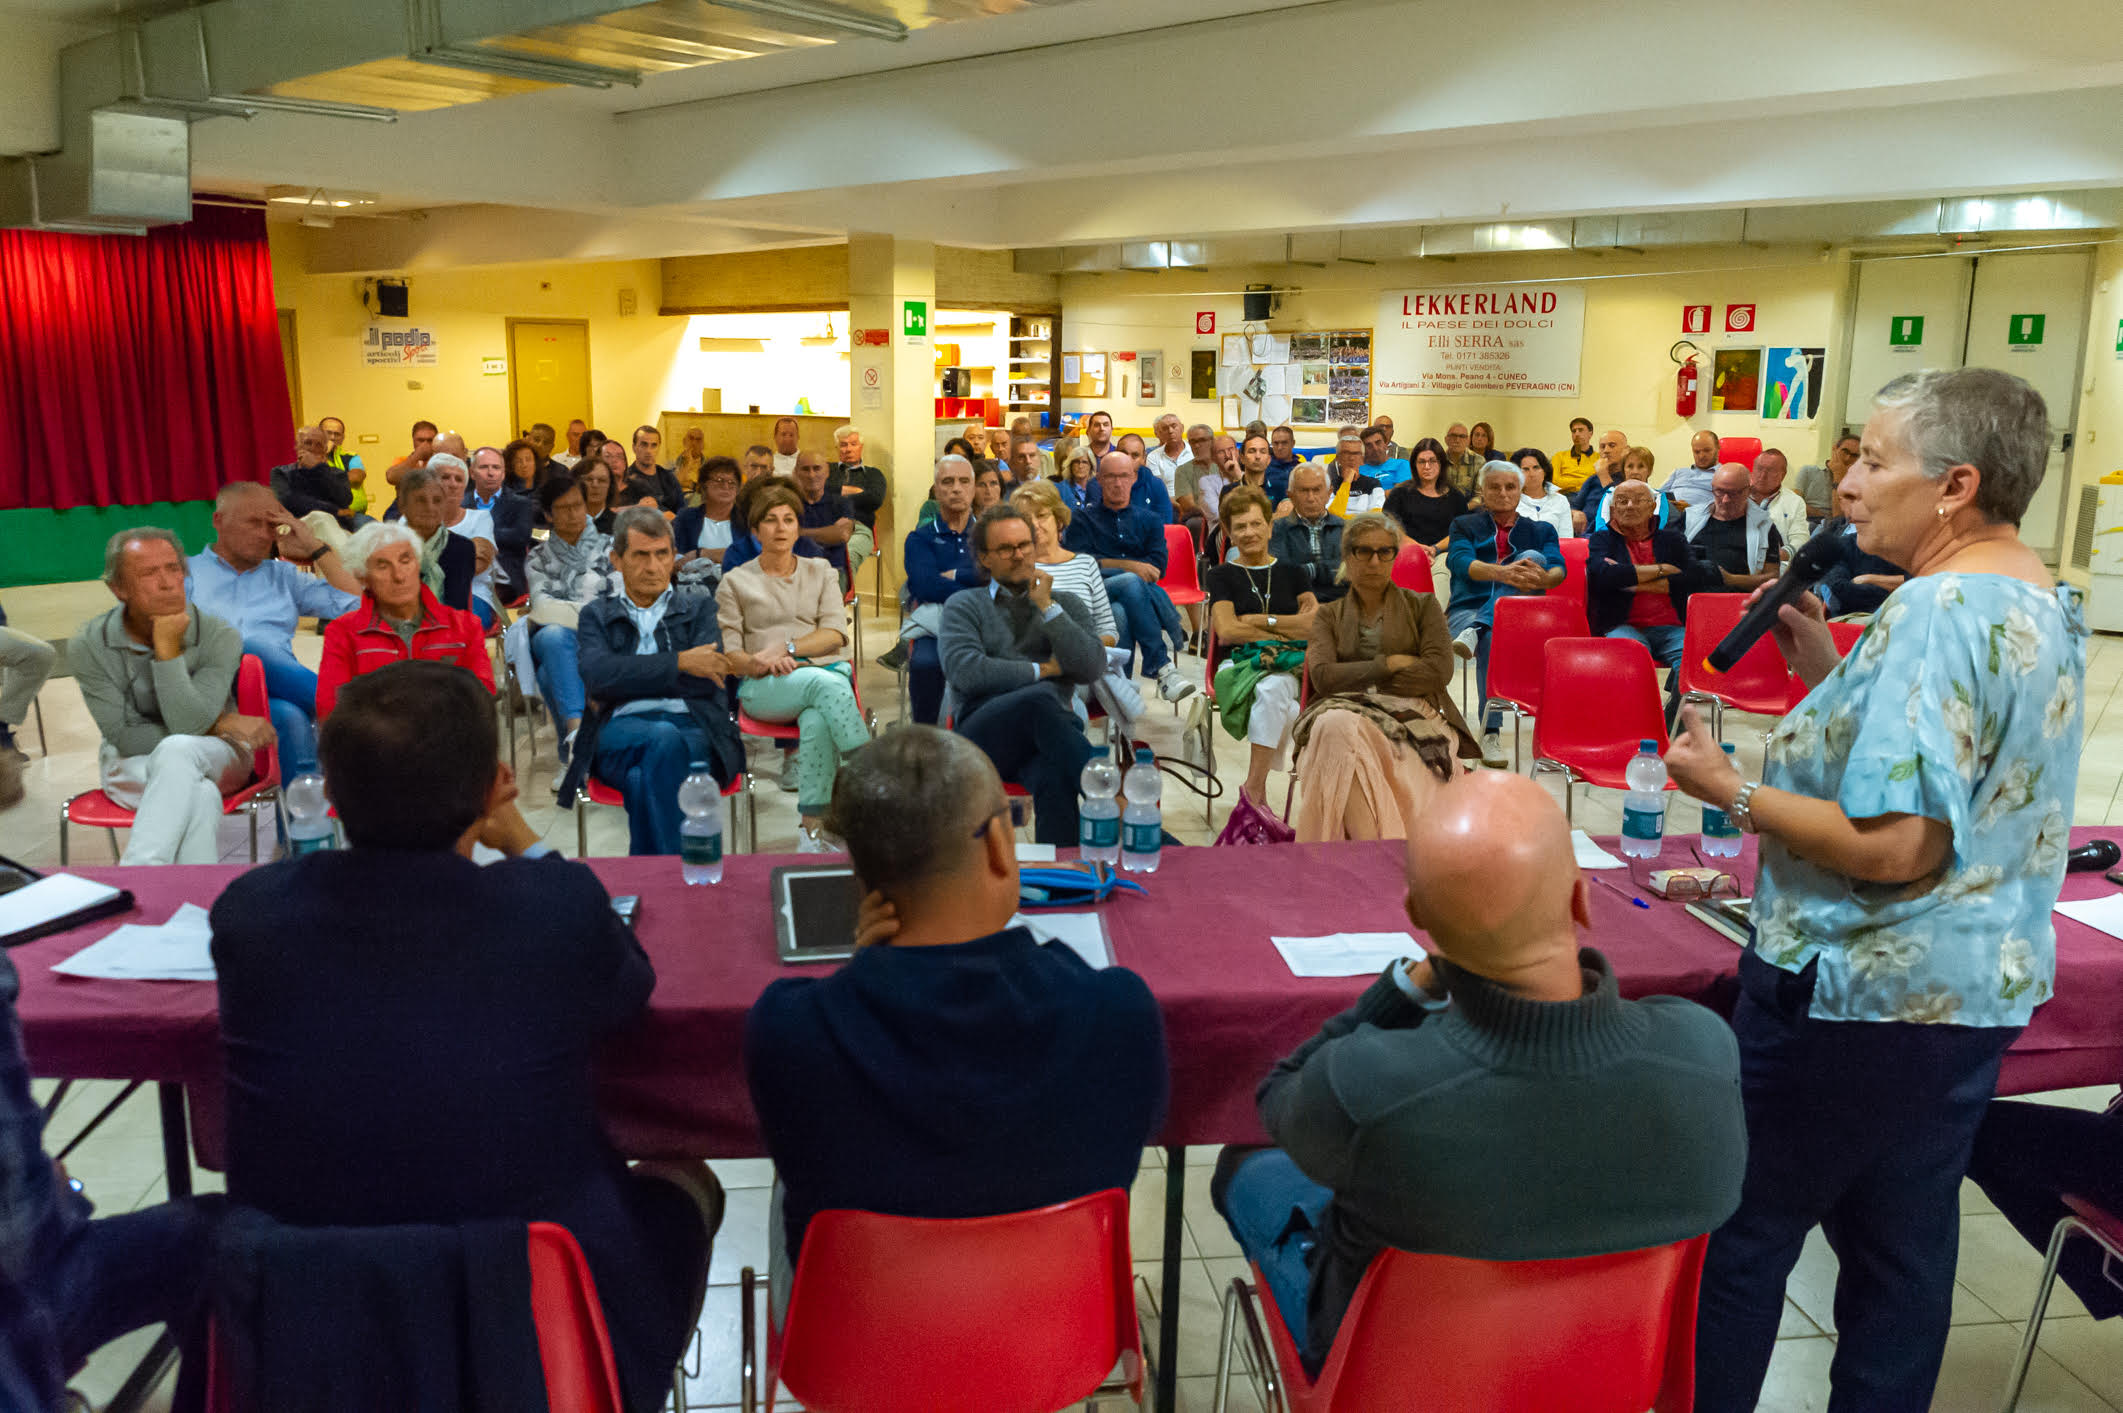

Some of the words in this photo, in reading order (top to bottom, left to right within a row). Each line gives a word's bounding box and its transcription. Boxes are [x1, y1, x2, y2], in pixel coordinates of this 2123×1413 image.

[1403, 292, 1557, 315] LEKKERLAND
[1401, 321, 1412, 329] IL
[1417, 321, 1468, 329] PAESE
[1472, 320, 1498, 329] DEI
[1504, 319, 1554, 328] DOLCI
[382, 328, 430, 350] podio
[1454, 335, 1504, 348] SERRA
[1456, 352, 1477, 360] 0171
[1497, 373, 1528, 381] CUNEO
[1379, 381, 1390, 389] Via
[1432, 382, 1463, 391] Villaggio
[1506, 382, 1557, 391] PEVERAGNO
[1558, 383, 1576, 392] (CN)
